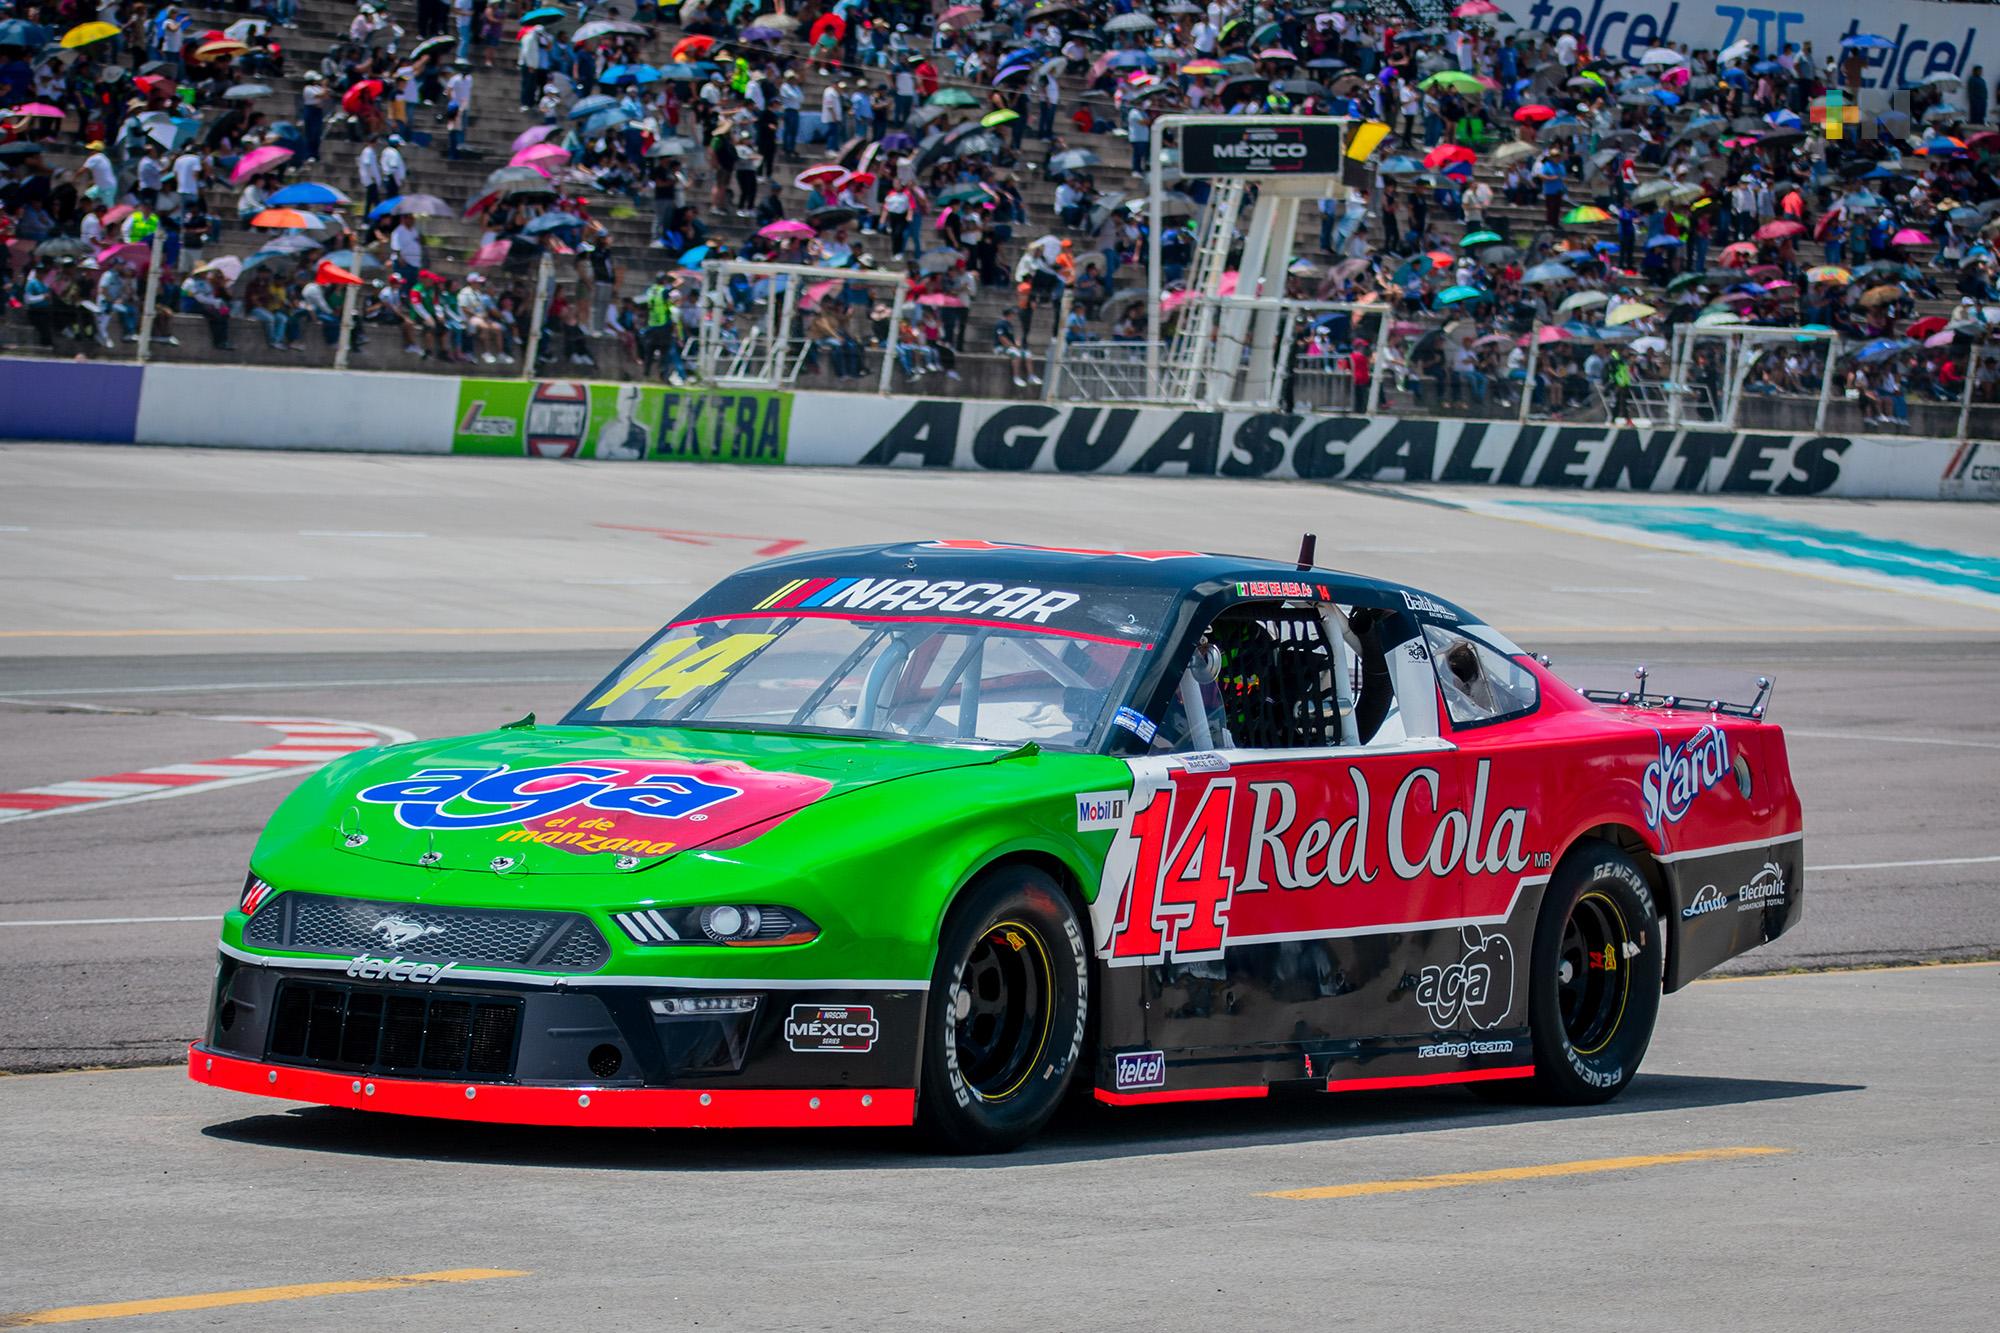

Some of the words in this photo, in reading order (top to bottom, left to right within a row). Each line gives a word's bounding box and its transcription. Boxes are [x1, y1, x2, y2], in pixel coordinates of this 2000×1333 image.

[1838, 19, 1976, 89] telcel
[1213, 141, 1307, 158] MÉXICO
[656, 392, 781, 458] EXTRA
[857, 400, 1851, 496] AGUASCALIENTES
[822, 578, 1080, 624] NASCAR
[1316, 584, 1331, 600] 14
[586, 633, 778, 710] 14
[357, 765, 743, 831] aga
[1080, 800, 1110, 821] Mobil
[496, 828, 678, 854] manzana
[545, 816, 576, 830] el
[583, 817, 616, 831] de
[1235, 766, 1379, 892] Red
[1387, 759, 1530, 879] Cola
[1534, 851, 1551, 868] MR
[1108, 780, 1235, 963] 14
[1592, 862, 1653, 919] GENERAL
[1739, 880, 1785, 902] Electrolit
[1683, 884, 1729, 917] Linde
[346, 953, 459, 984] telcel
[1063, 918, 1088, 1062] GENERAL
[1416, 964, 1490, 1028] aga
[789, 1020, 874, 1037] MÉXICO
[822, 1011, 849, 1020] NASCAR
[945, 965, 970, 1108] GENERAL
[1418, 1042, 1469, 1058] racing
[1471, 1040, 1513, 1053] team
[1119, 1057, 1162, 1083] telcel
